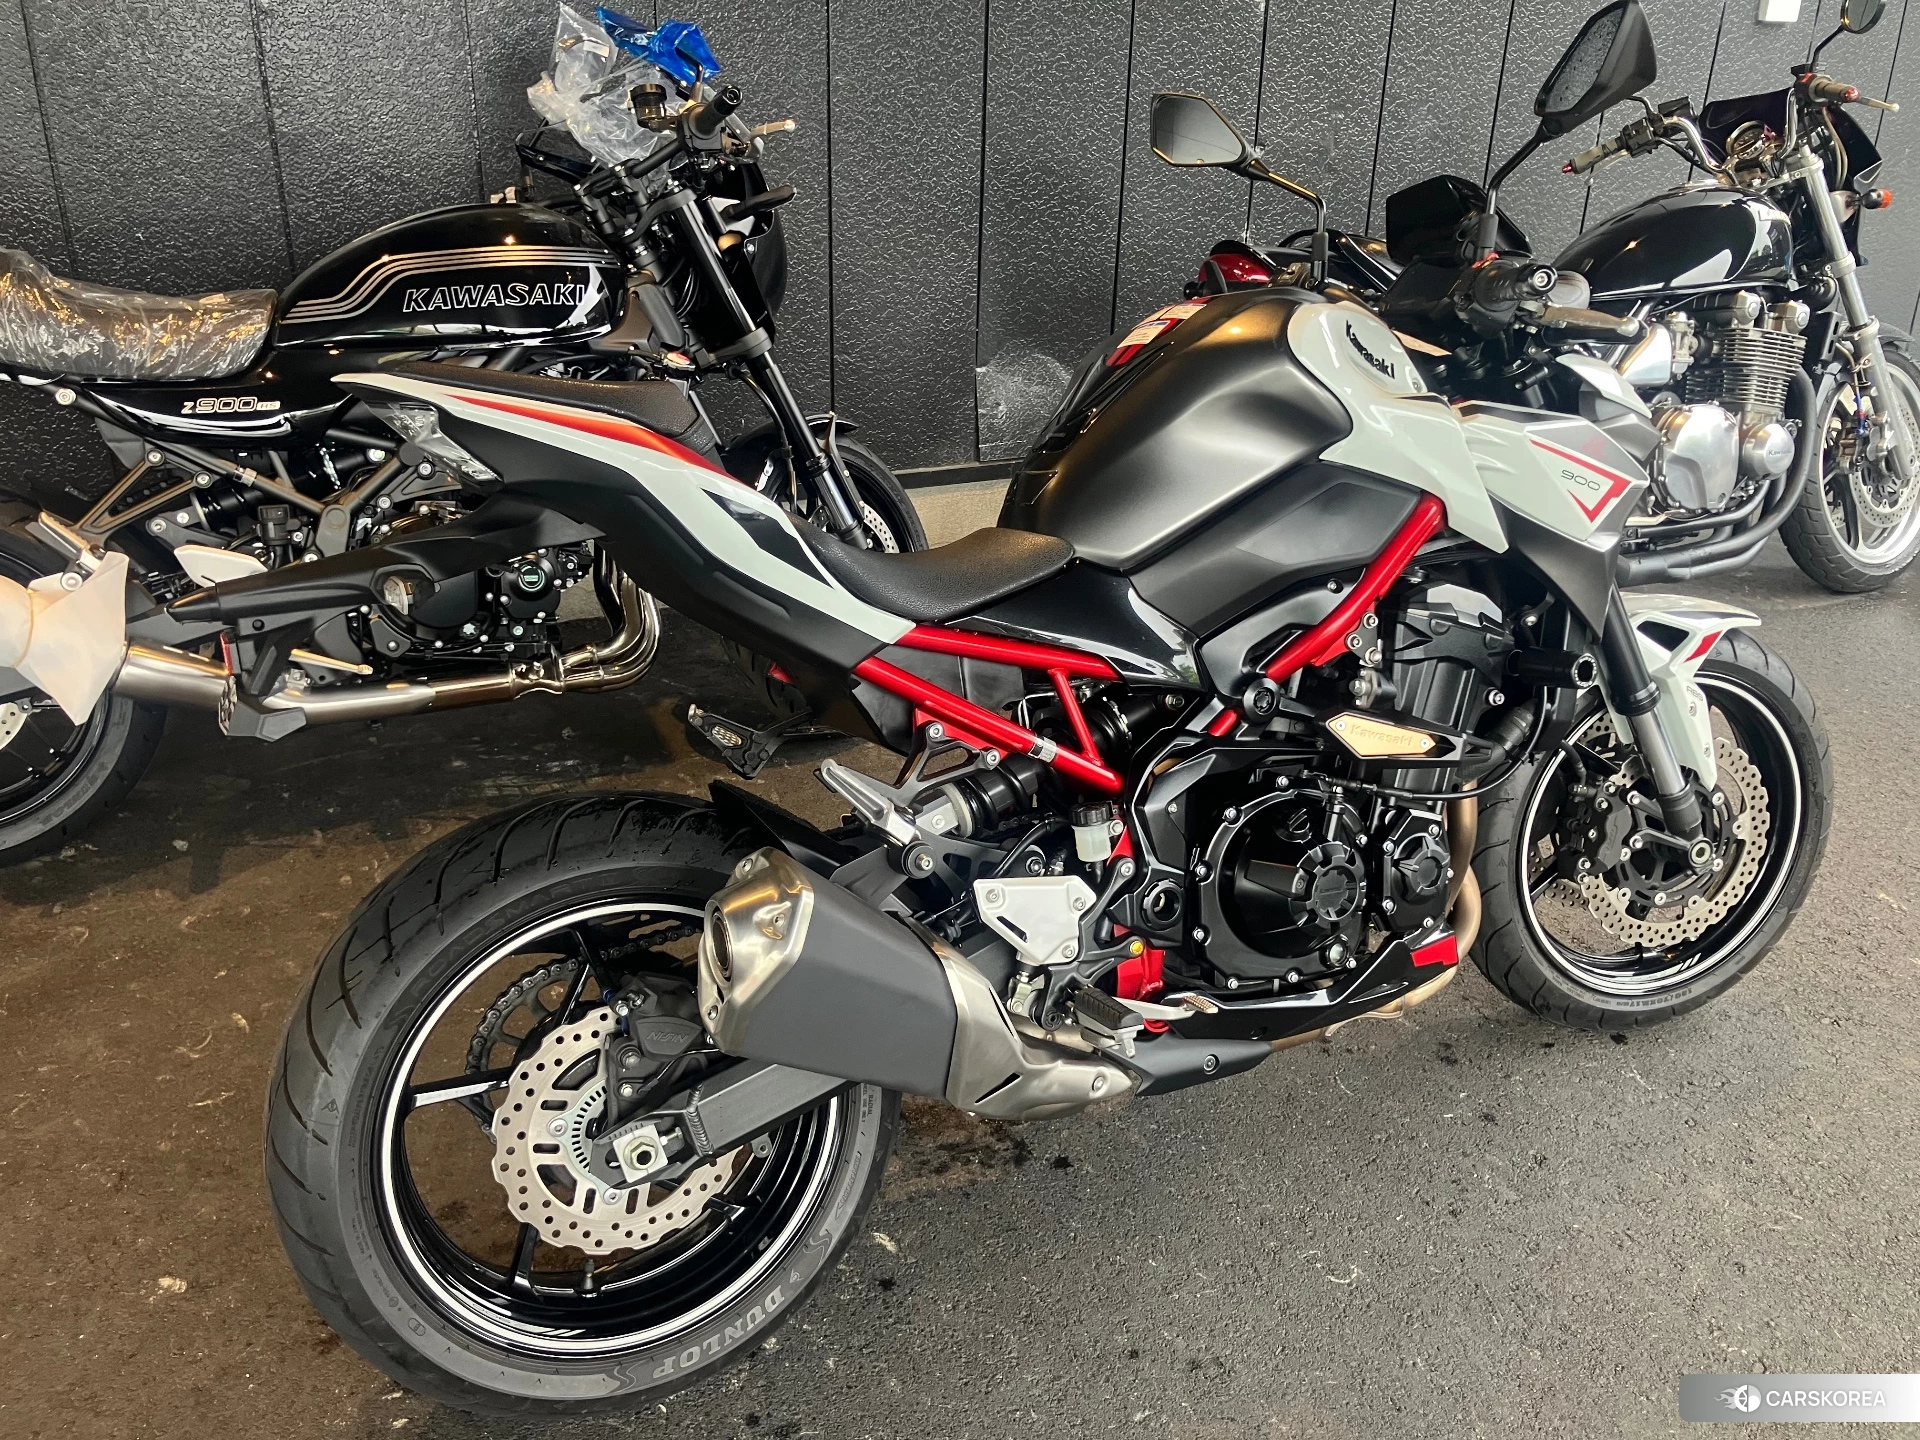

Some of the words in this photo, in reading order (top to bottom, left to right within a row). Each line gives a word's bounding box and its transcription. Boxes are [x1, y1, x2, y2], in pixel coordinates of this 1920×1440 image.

[402, 282, 586, 313] KAWASAKI
[1345, 319, 1396, 380] Kawasaki
[1560, 469, 1601, 491] 900
[1349, 723, 1413, 747] Kawasaki
[652, 1284, 786, 1379] DUNLOP
